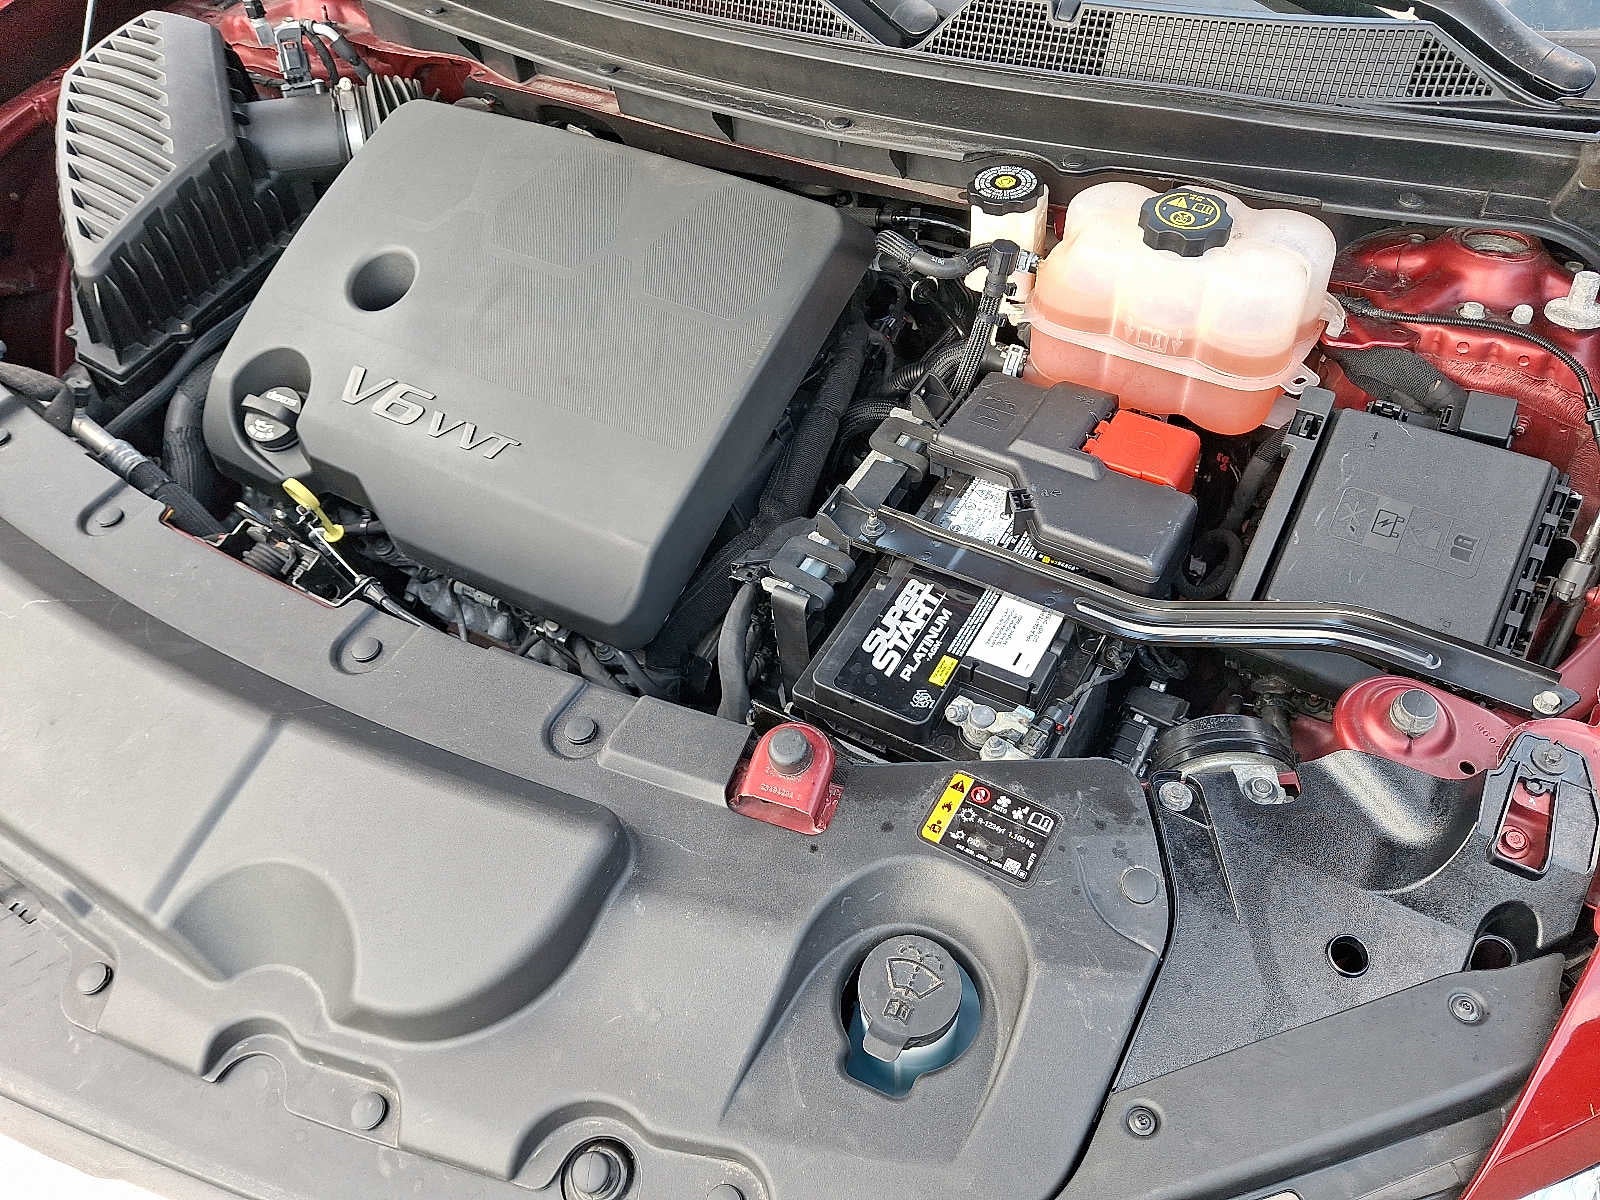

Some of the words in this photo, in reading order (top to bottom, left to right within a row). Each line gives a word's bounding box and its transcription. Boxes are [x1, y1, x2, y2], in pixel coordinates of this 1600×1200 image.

[342, 365, 437, 426] V6
[427, 410, 522, 460] VVT
[861, 578, 926, 655] SUPER
[871, 583, 939, 677] START
[899, 607, 953, 682] PLATINUM
[991, 803, 1008, 815] AUTO
